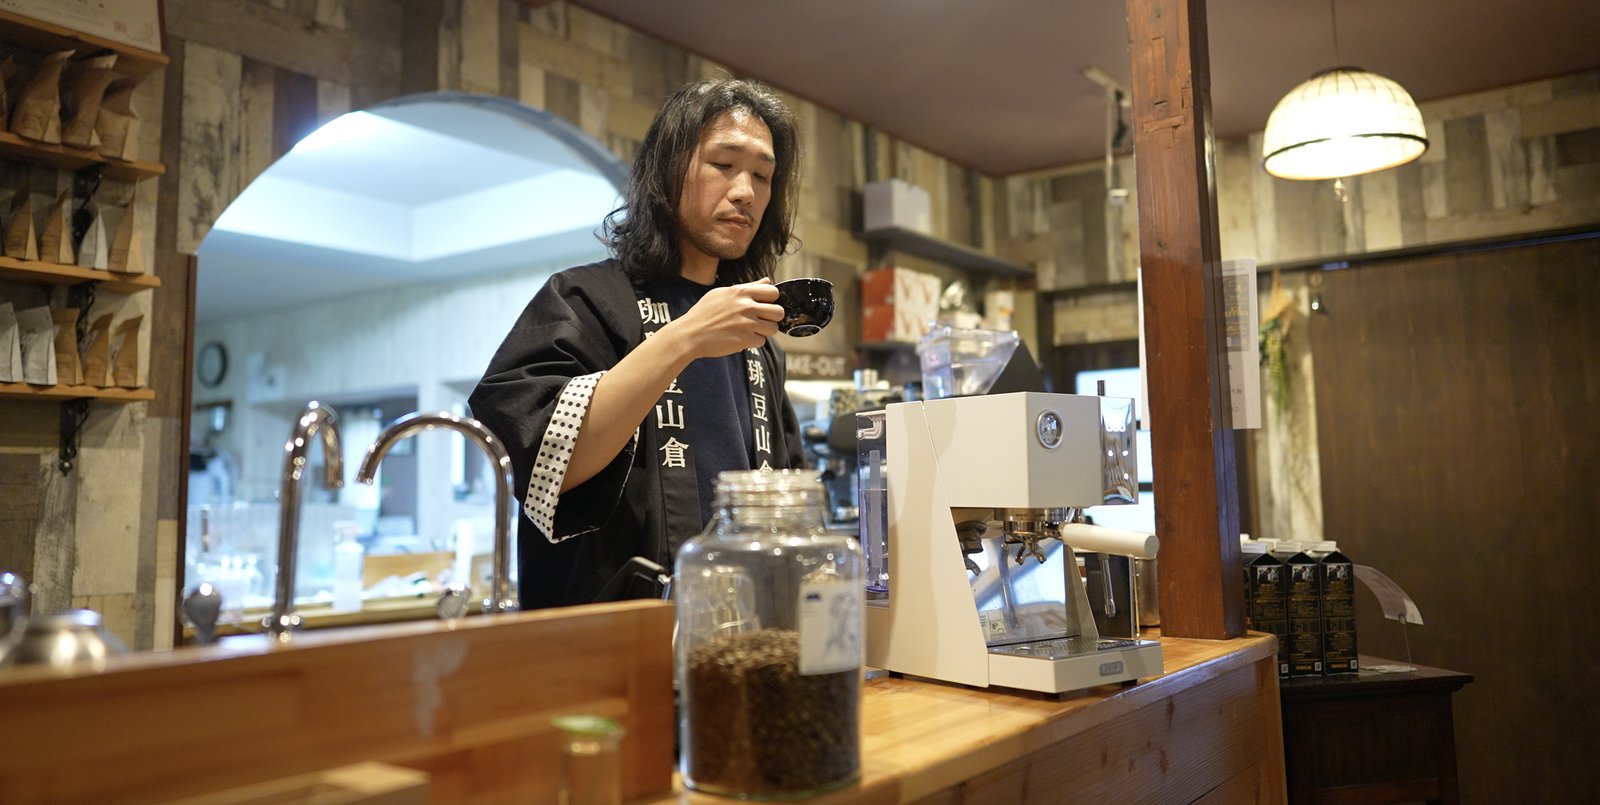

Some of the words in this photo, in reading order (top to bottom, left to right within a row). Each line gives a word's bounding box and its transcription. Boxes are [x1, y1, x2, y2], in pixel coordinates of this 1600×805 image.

[637, 297, 689, 468] 珈山倉
[746, 347, 773, 474] 琲豆山
